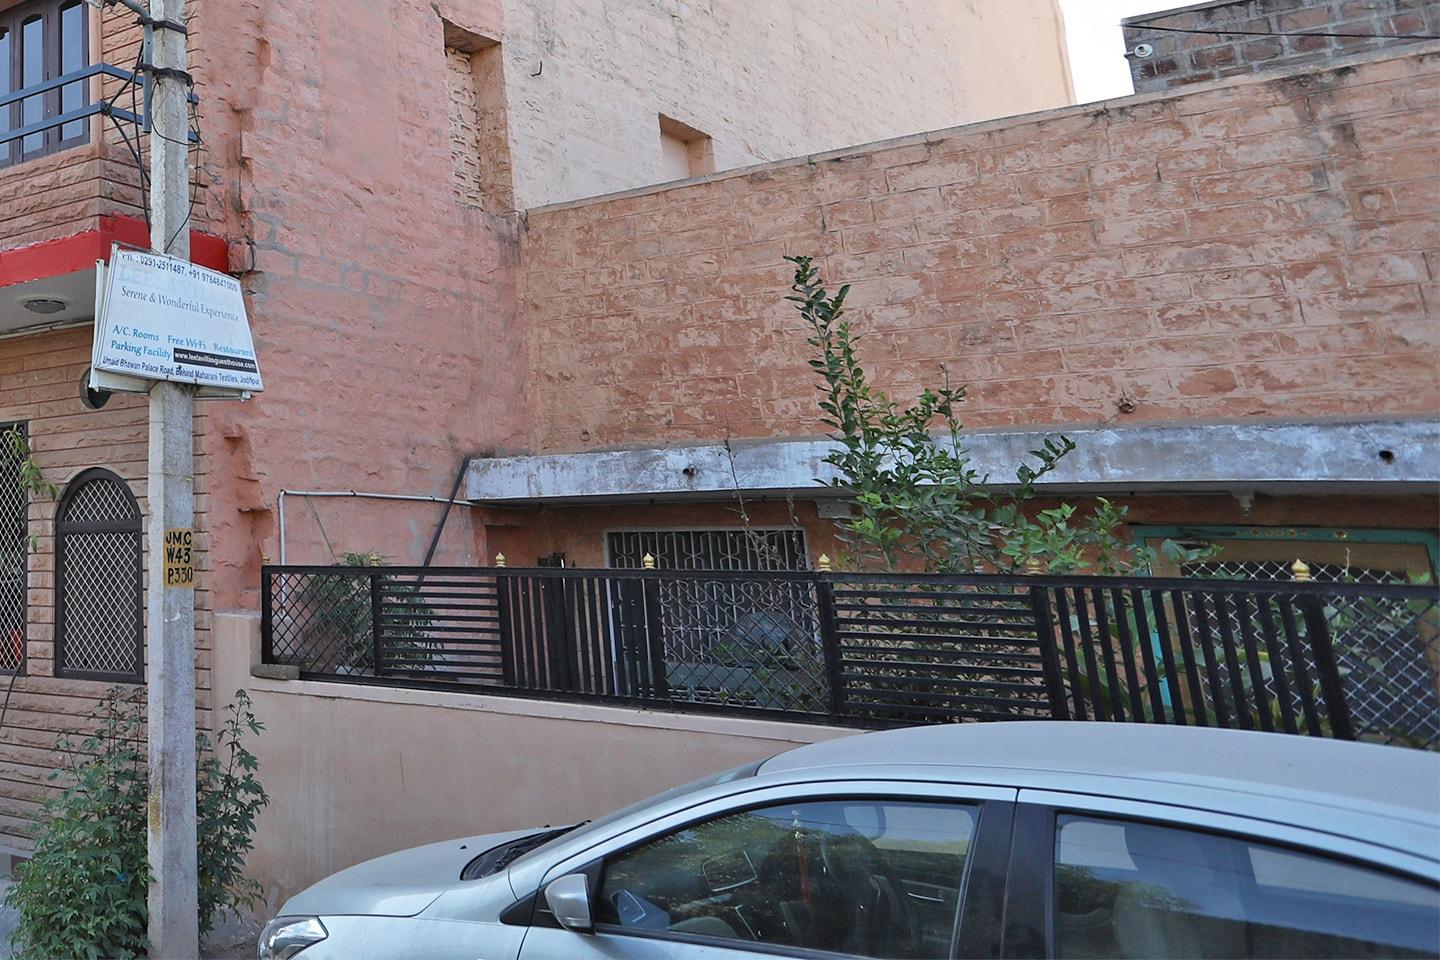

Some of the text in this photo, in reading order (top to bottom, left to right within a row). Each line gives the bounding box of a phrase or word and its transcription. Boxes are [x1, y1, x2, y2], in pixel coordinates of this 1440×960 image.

[188, 269, 200, 281] +91
[121, 285, 148, 302] Serene
[149, 292, 157, 304] &
[158, 293, 200, 313] Wonderful
[200, 303, 240, 322] Experience
[111, 340, 255, 370] Parking Facility www.leelavillasguesthouse.com
[112, 324, 253, 357] A/C. Rooms Free Wi-Fi Restaurant
[102, 355, 120, 367] Umaid
[119, 358, 140, 370] Bhawan
[141, 361, 159, 373] Palace
[159, 364, 175, 376] Road,
[175, 367, 194, 378] Behind
[194, 369, 218, 381] Maharani
[219, 372, 239, 384] Textiles,
